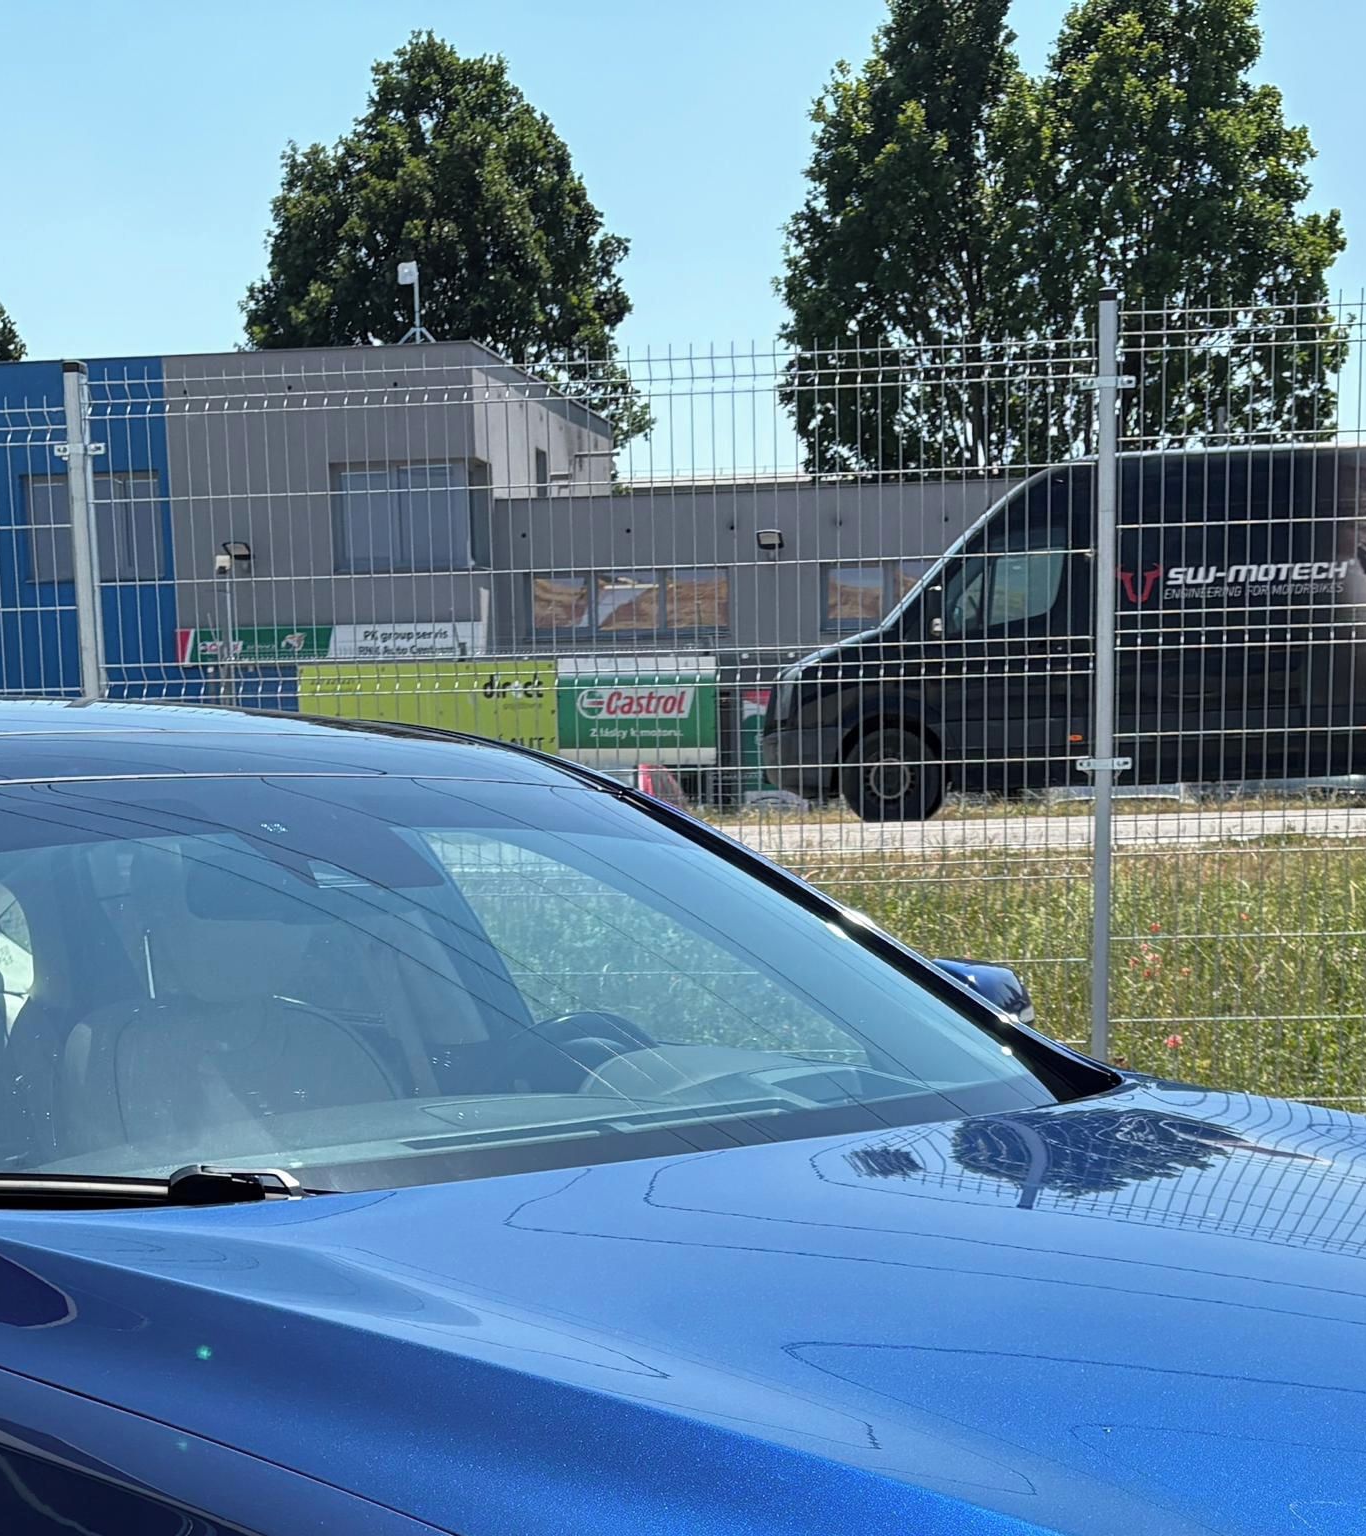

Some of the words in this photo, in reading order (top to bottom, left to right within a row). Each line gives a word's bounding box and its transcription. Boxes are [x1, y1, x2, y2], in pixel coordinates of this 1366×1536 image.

[1166, 561, 1349, 585] SW-MOTECH
[1164, 585, 1242, 600] ENGINEERING
[1246, 584, 1269, 597] FOR
[1272, 582, 1345, 596] MOTORBIKES
[606, 691, 686, 715] Castrol
